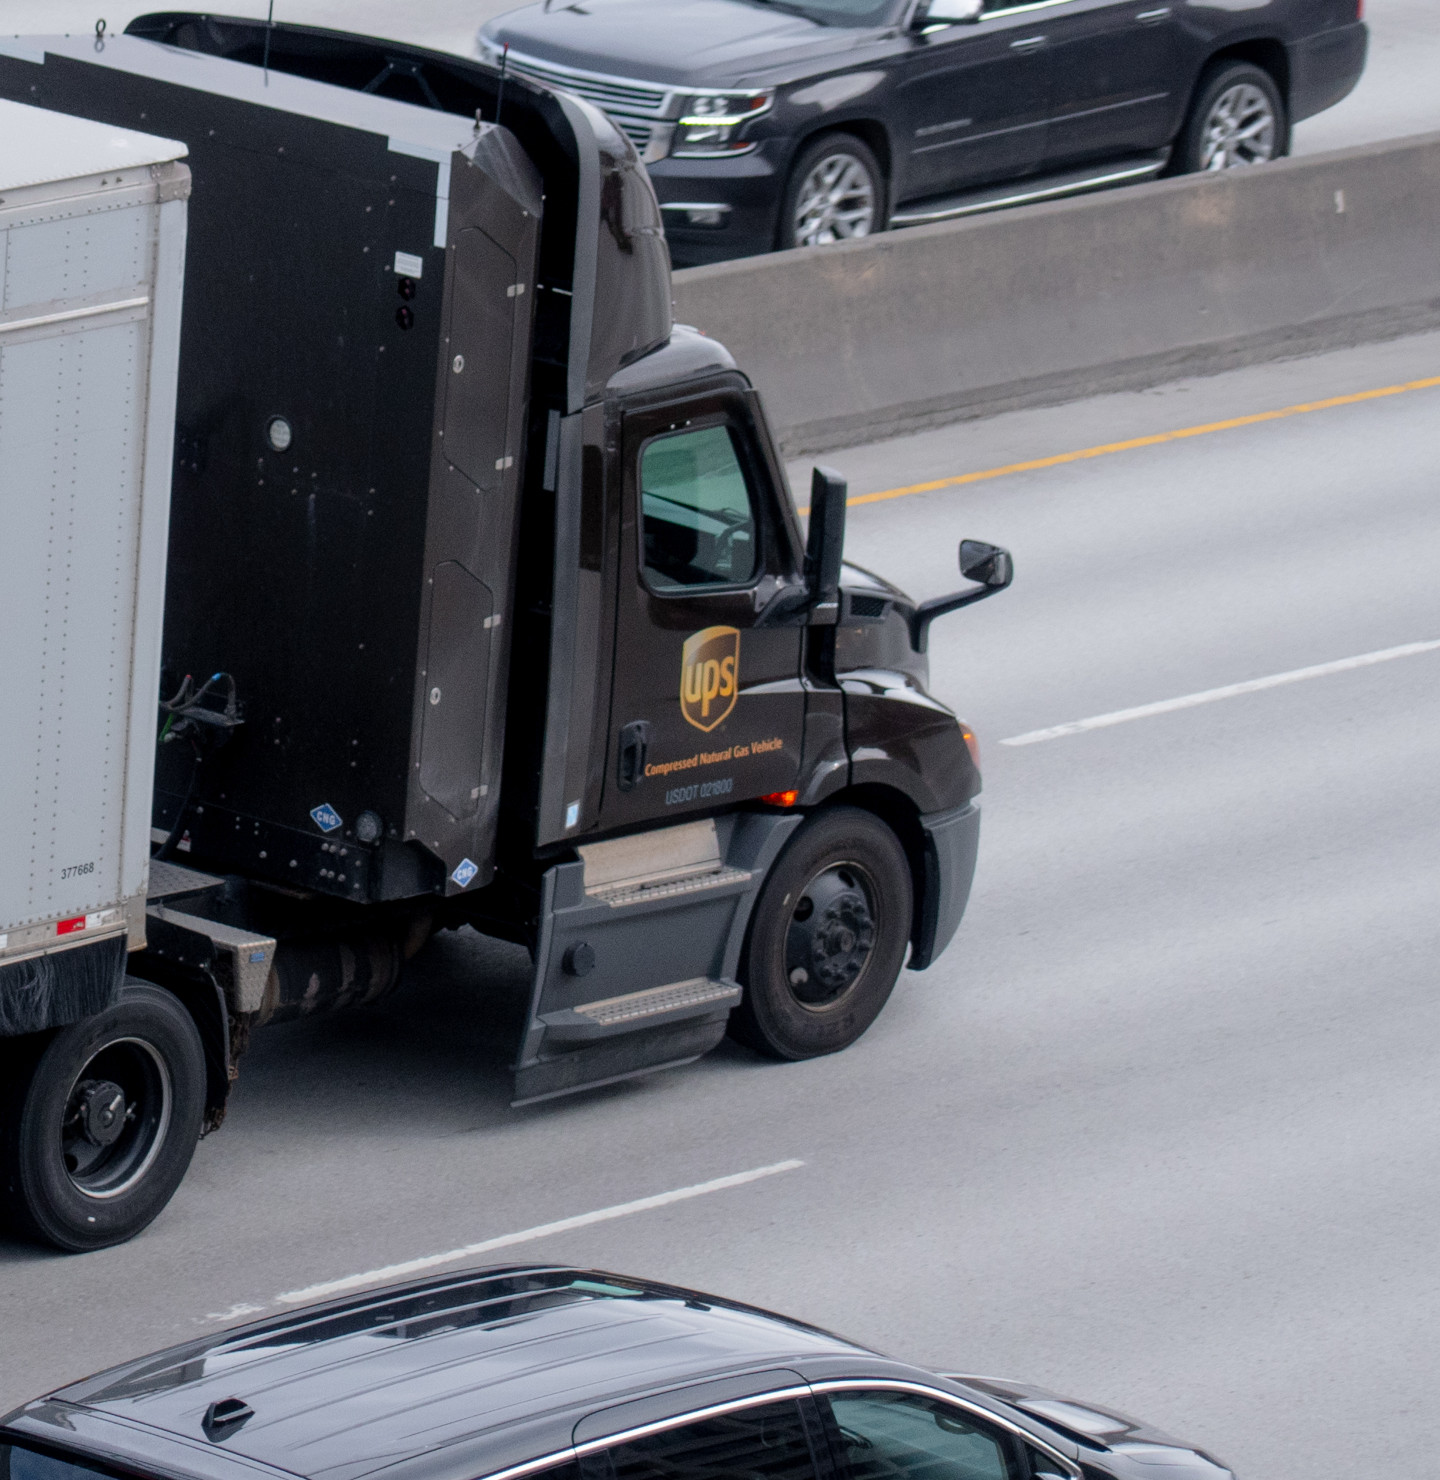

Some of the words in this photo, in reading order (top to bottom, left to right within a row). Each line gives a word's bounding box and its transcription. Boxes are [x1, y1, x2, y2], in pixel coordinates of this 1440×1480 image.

[685, 656, 735, 717] ups
[645, 754, 698, 777] Compressed
[700, 747, 732, 765] Natural
[733, 745, 749, 758] Gas
[751, 737, 783, 754] Vehicle
[665, 784, 699, 805] USDOT
[317, 811, 335, 825] CNG
[61, 862, 94, 879] 377668
[456, 866, 472, 880] CNG
